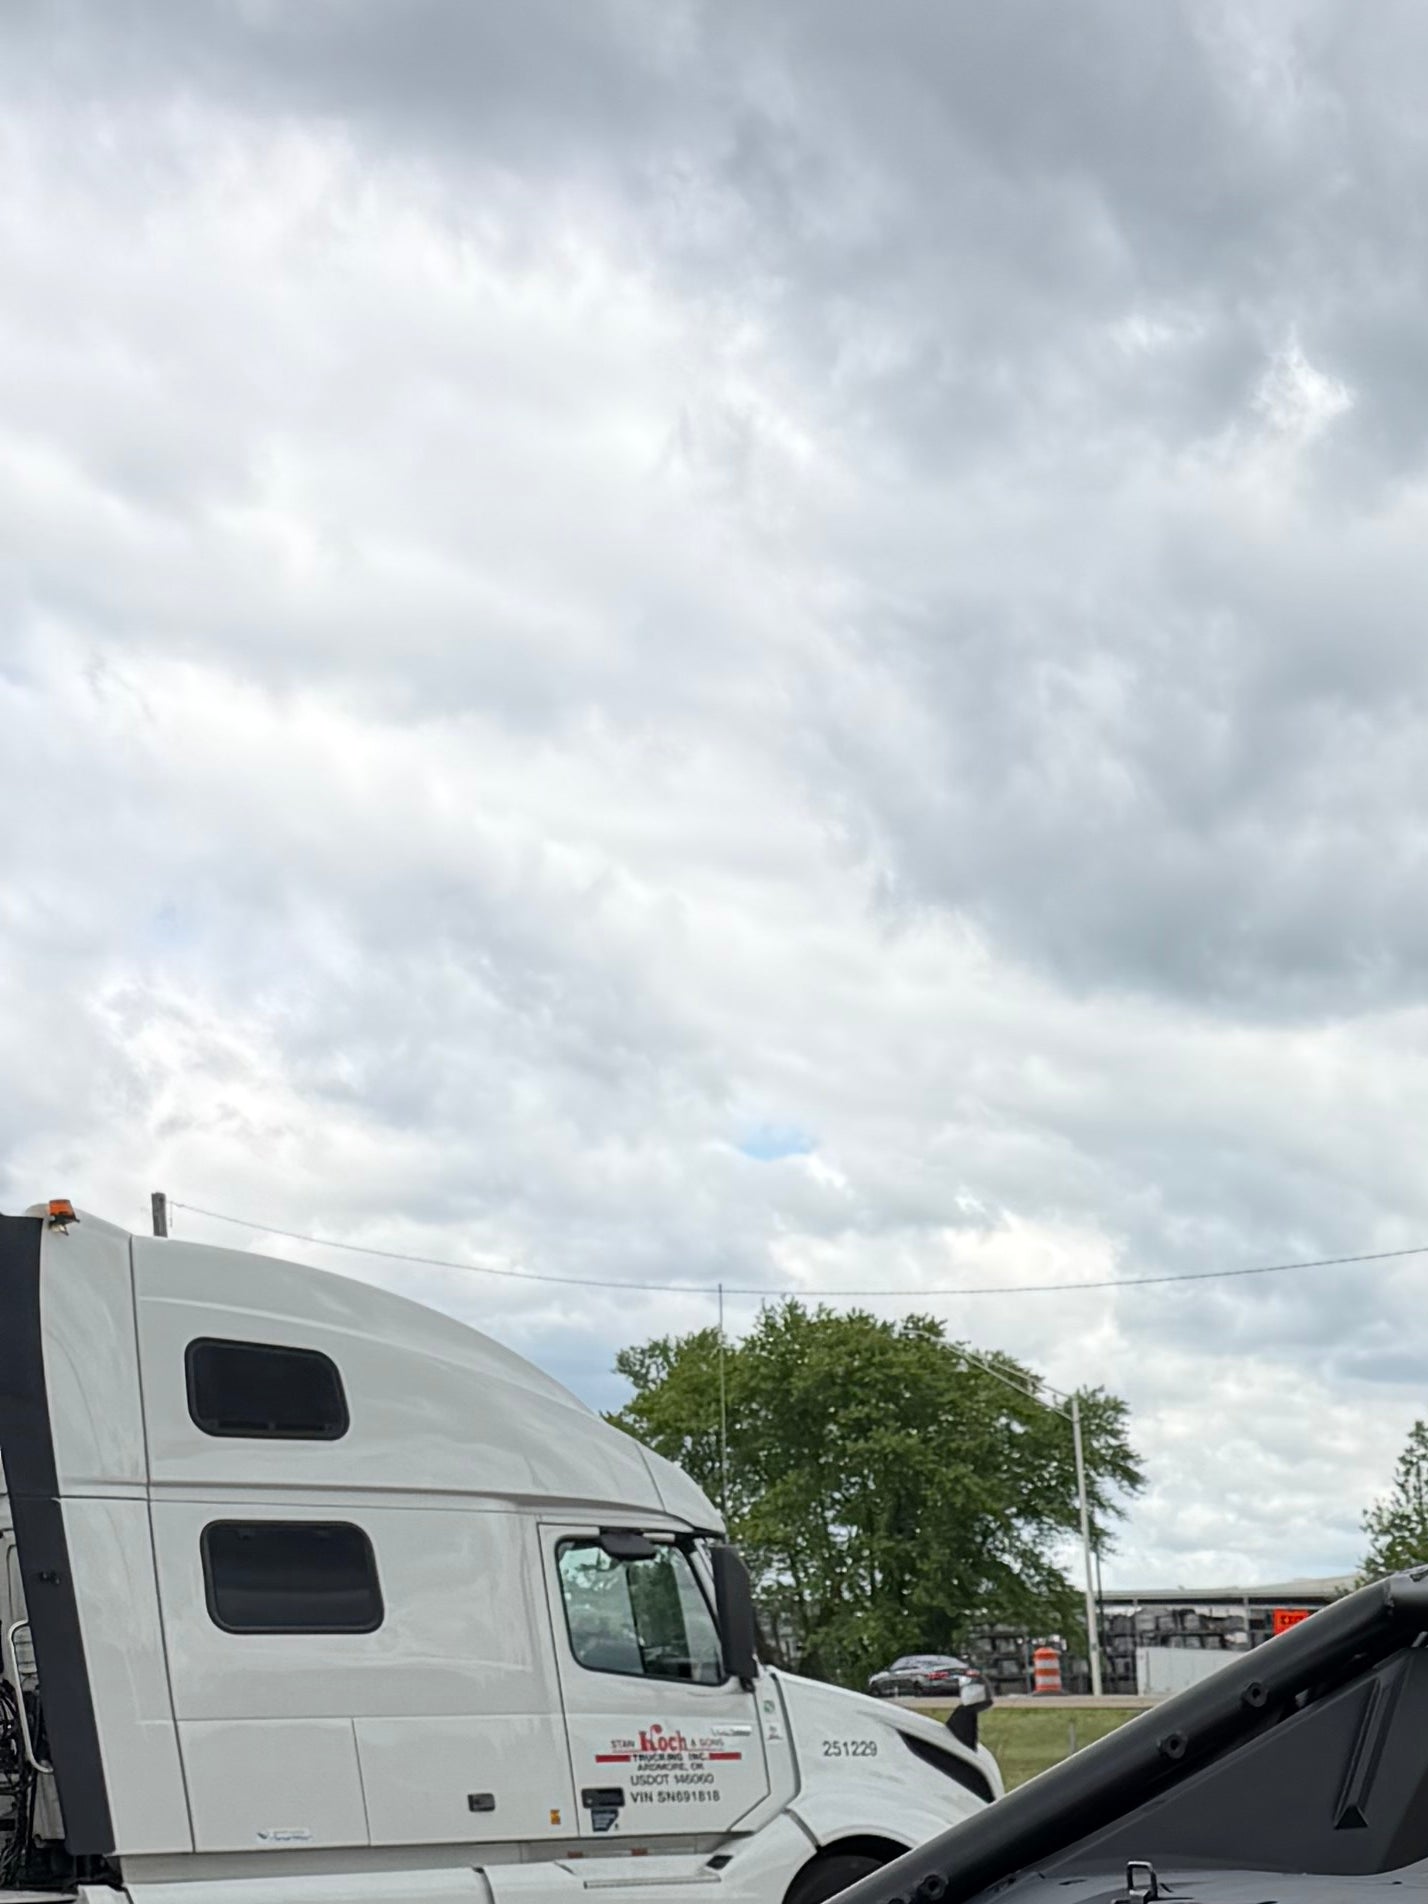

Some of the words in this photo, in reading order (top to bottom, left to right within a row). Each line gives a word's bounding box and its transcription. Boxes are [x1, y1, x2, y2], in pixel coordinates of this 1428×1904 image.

[822, 1740, 878, 1757] 251229
[630, 1774, 670, 1786] USDOT
[630, 1791, 654, 1803] VIN
